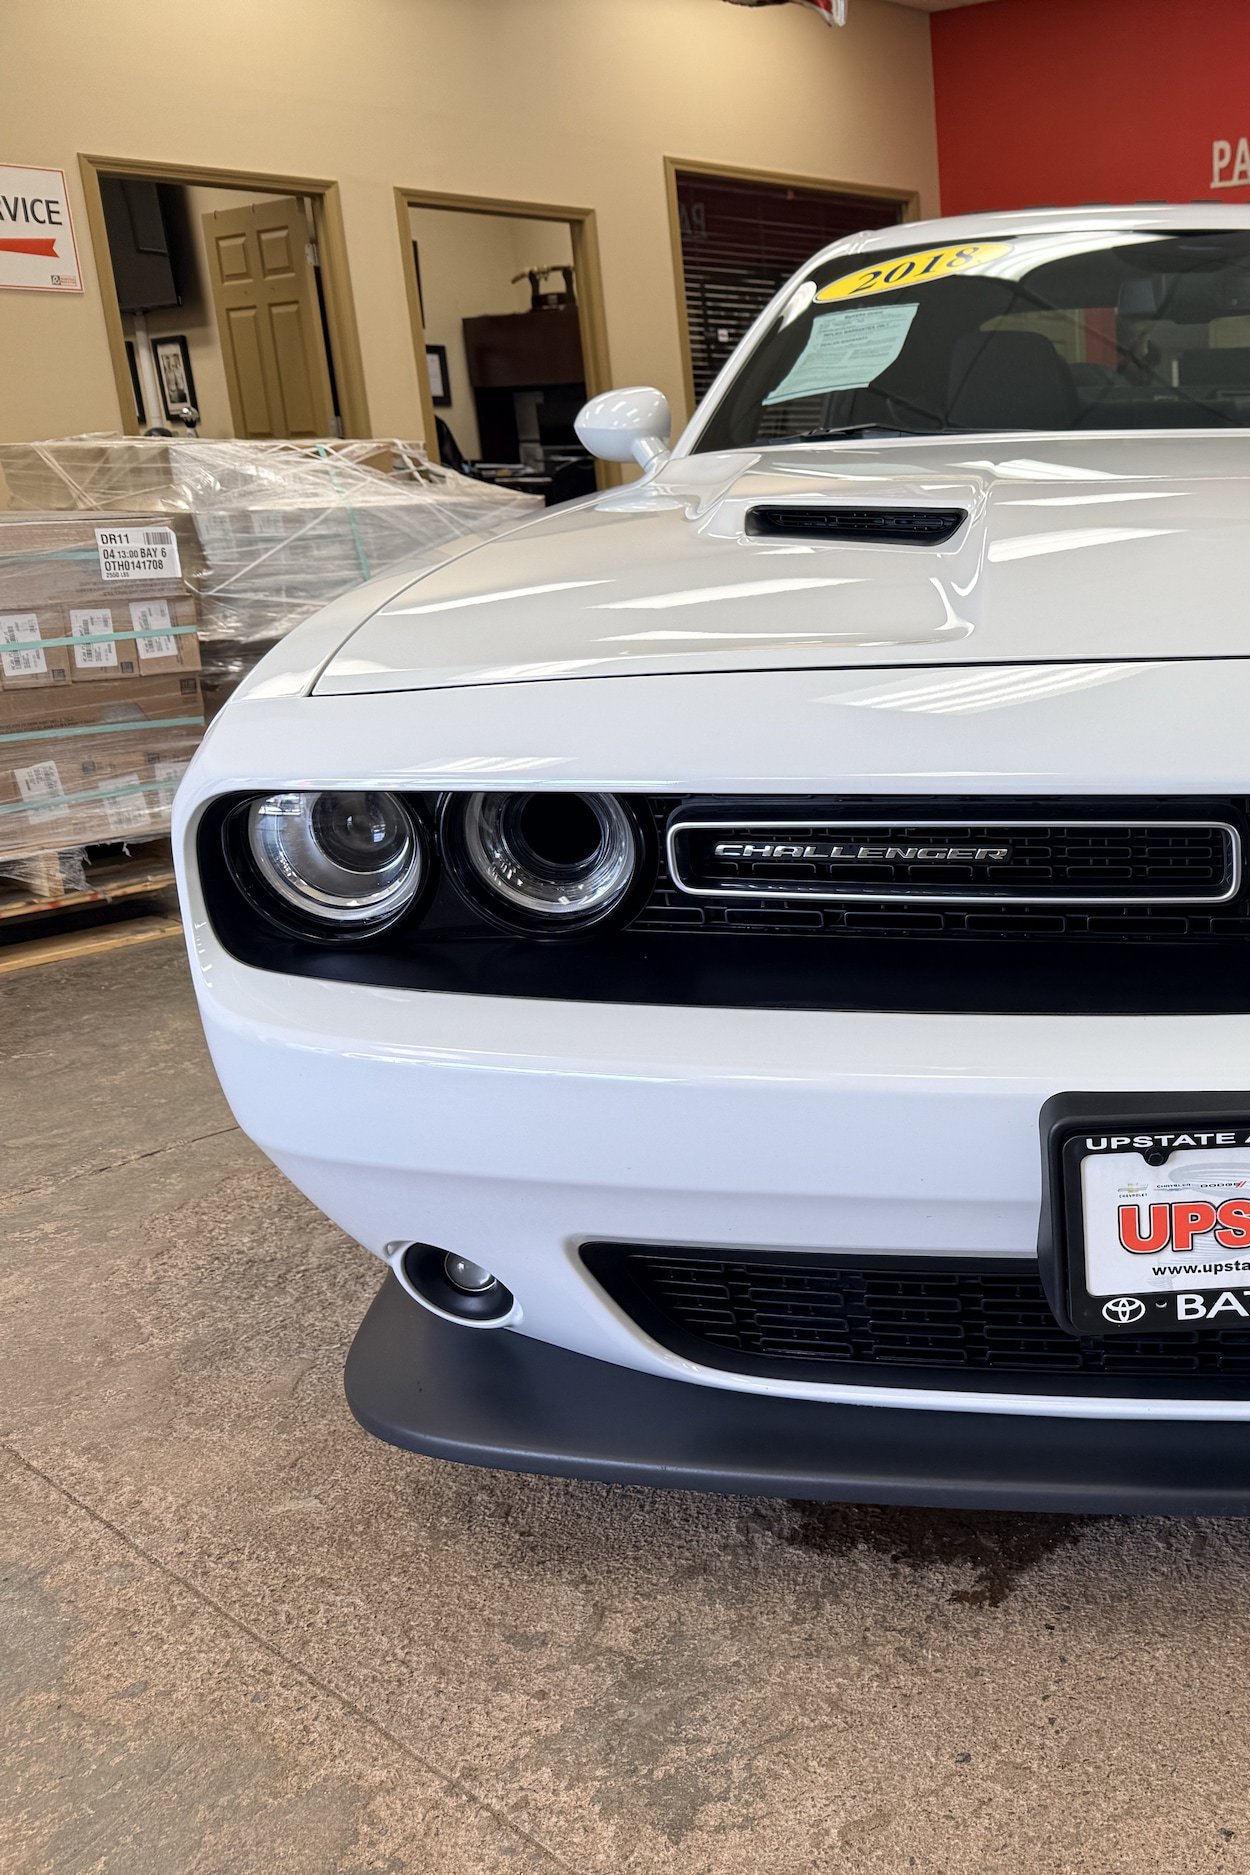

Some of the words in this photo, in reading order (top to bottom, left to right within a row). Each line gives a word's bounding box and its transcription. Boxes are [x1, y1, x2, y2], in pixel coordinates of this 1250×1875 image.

[0, 195, 63, 226] VICE
[848, 246, 980, 295] 2018
[100, 533, 130, 545] DR11
[103, 549, 115, 560] 04
[117, 550, 139, 559] 13:00
[140, 548, 158, 558] BAY
[161, 547, 167, 558] 6
[714, 844, 1008, 860] CHALLENGER
[1085, 1131, 1236, 1151] UPSTATE
